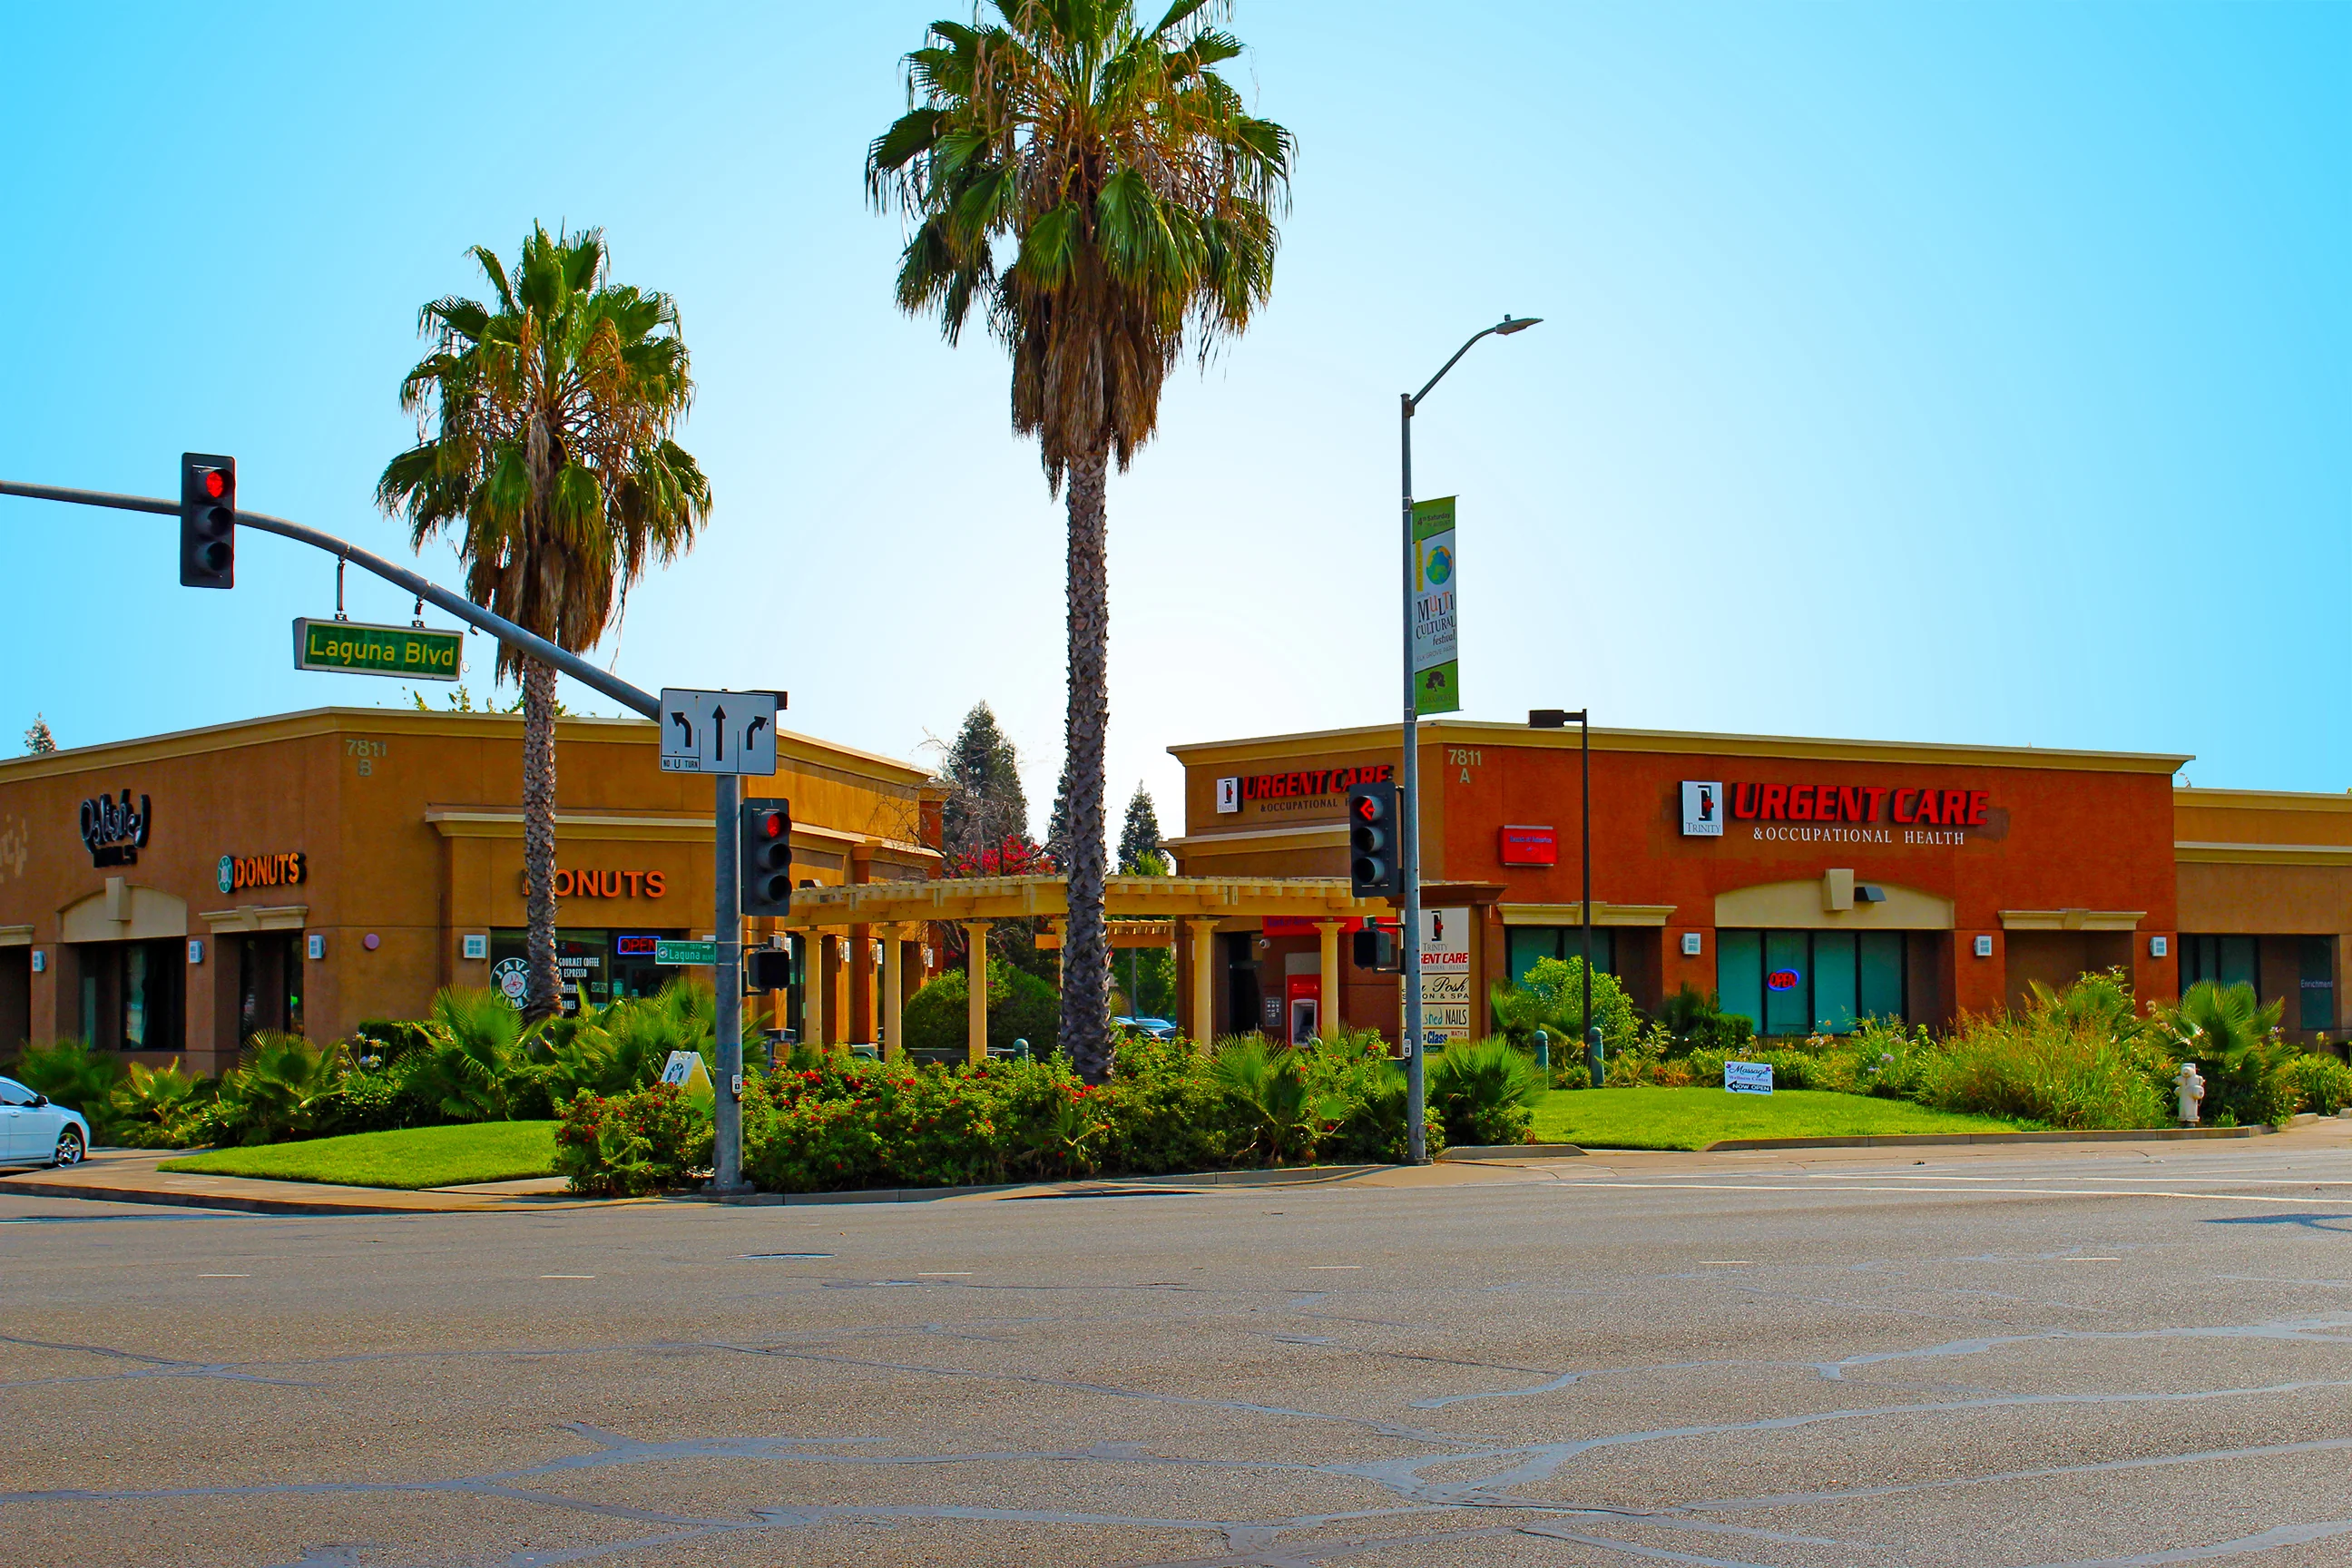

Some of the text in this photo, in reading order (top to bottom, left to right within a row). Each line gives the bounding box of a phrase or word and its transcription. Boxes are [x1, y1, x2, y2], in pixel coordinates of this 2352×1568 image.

[1416, 592, 1455, 623] MULTI
[1416, 615, 1456, 641] CULTURAL
[1432, 629, 1456, 646] festival
[309, 633, 455, 667] Laguna Blvd
[1426, 648, 1442, 659] GROVE
[1443, 645, 1456, 653] PARK
[346, 739, 387, 757] 7811
[663, 759, 699, 769] NO U TURN
[1447, 749, 1481, 766] 7811
[1242, 764, 1390, 800] URGENT CARE
[1459, 768, 1471, 784] A
[1734, 781, 1990, 825] URGENT CARE
[1685, 821, 1721, 834] TRINITY
[1905, 830, 1965, 846] HEALTH
[234, 852, 300, 888] DONUTS
[523, 868, 667, 898] ONUTS
[620, 938, 657, 954] OPEN
[1423, 943, 1449, 952] TRINITY
[558, 957, 600, 967] GOURMET COFFEE
[669, 948, 701, 964] Laguna
[1421, 952, 1469, 964] ENT CARE
[564, 968, 587, 978] ESPRESSO
[1769, 972, 1797, 987] OPEN
[592, 983, 607, 992] OPEN
[1432, 976, 1469, 993] Posh
[1446, 1009, 1467, 1025] NAILS
[1427, 1030, 1448, 1044] Class
[1729, 1064, 1769, 1078] Massage
